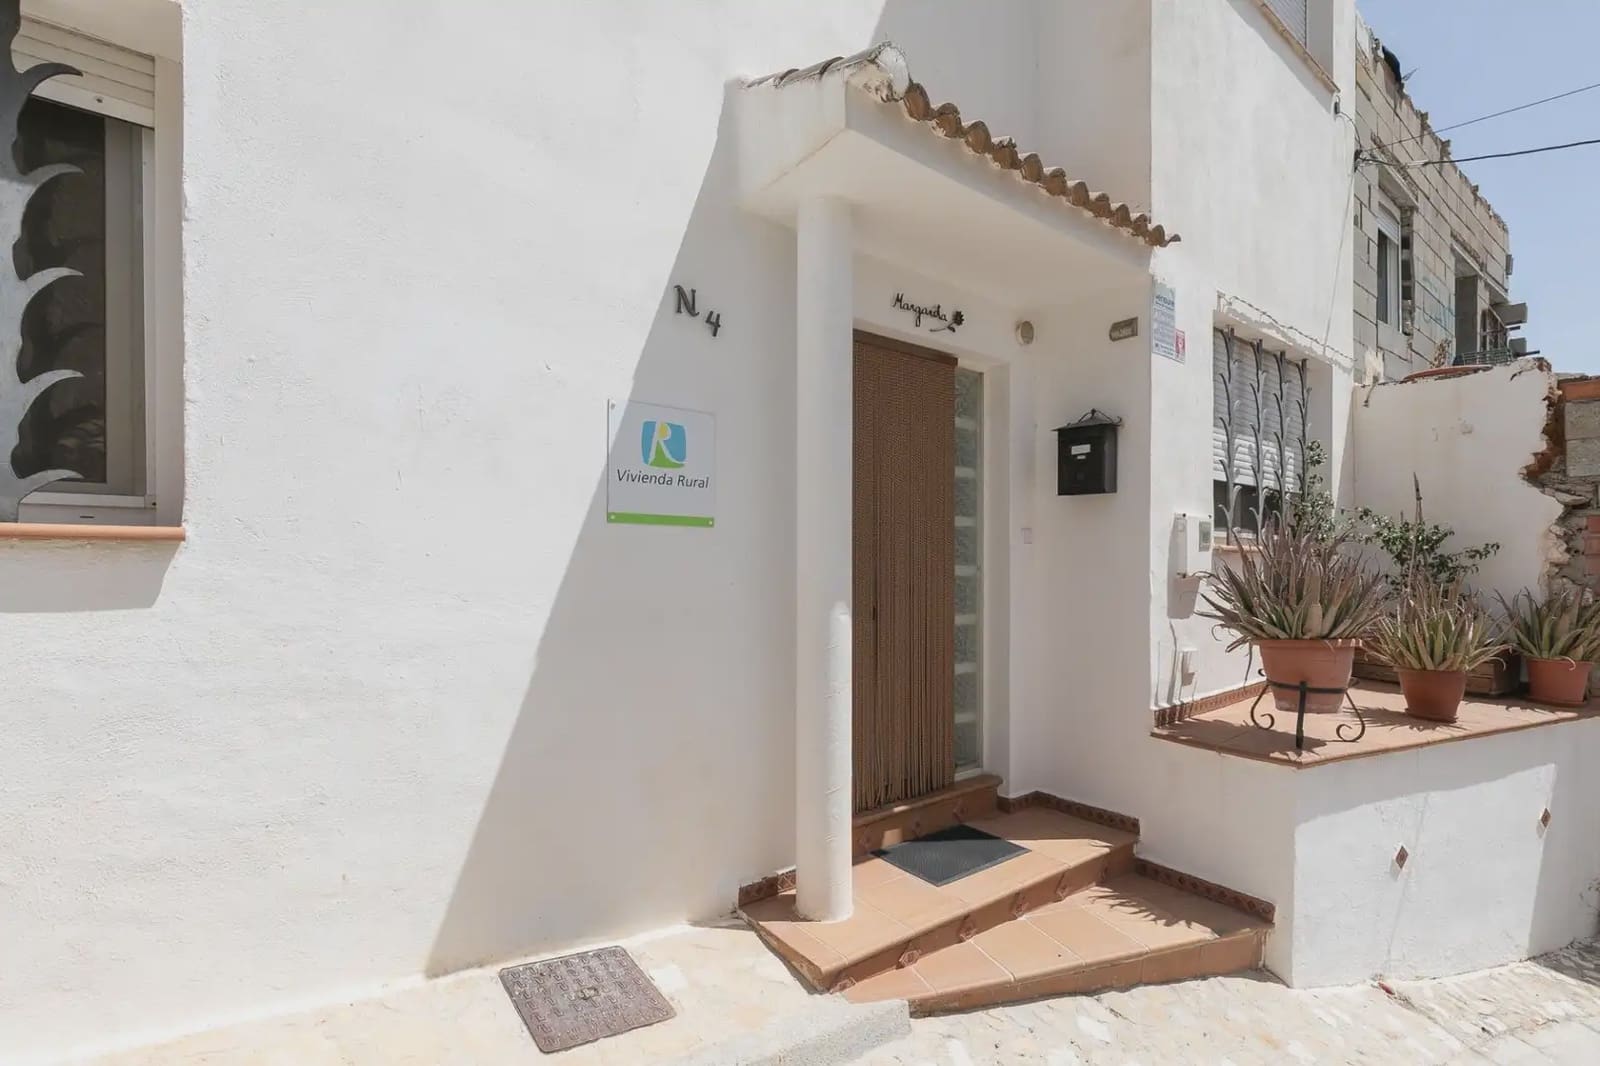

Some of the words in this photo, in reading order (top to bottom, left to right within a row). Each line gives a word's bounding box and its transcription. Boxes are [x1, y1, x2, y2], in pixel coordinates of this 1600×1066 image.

[674, 285, 699, 317] N
[705, 310, 721, 337] 4
[617, 469, 673, 486] Vivienda
[677, 474, 710, 488] Rural
